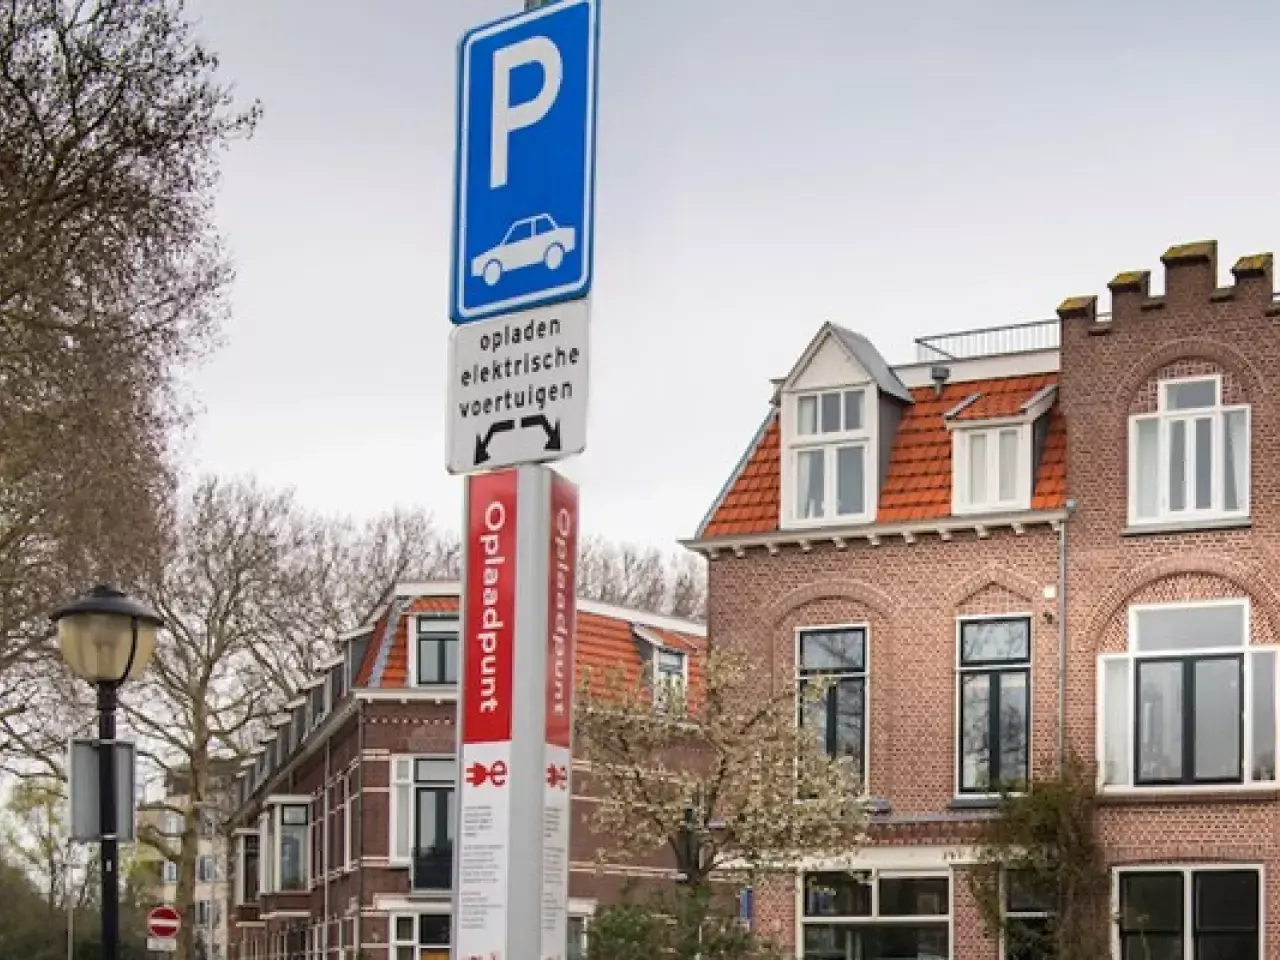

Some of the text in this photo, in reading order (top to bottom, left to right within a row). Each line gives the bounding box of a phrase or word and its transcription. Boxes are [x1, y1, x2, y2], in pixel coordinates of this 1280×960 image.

[489, 35, 563, 189] P
[461, 346, 580, 386] elektrische
[480, 319, 561, 352] opladen
[459, 381, 573, 417] voertuigen
[477, 501, 506, 713] Oplaadpunt
[553, 508, 570, 715] Oplaadpunt
